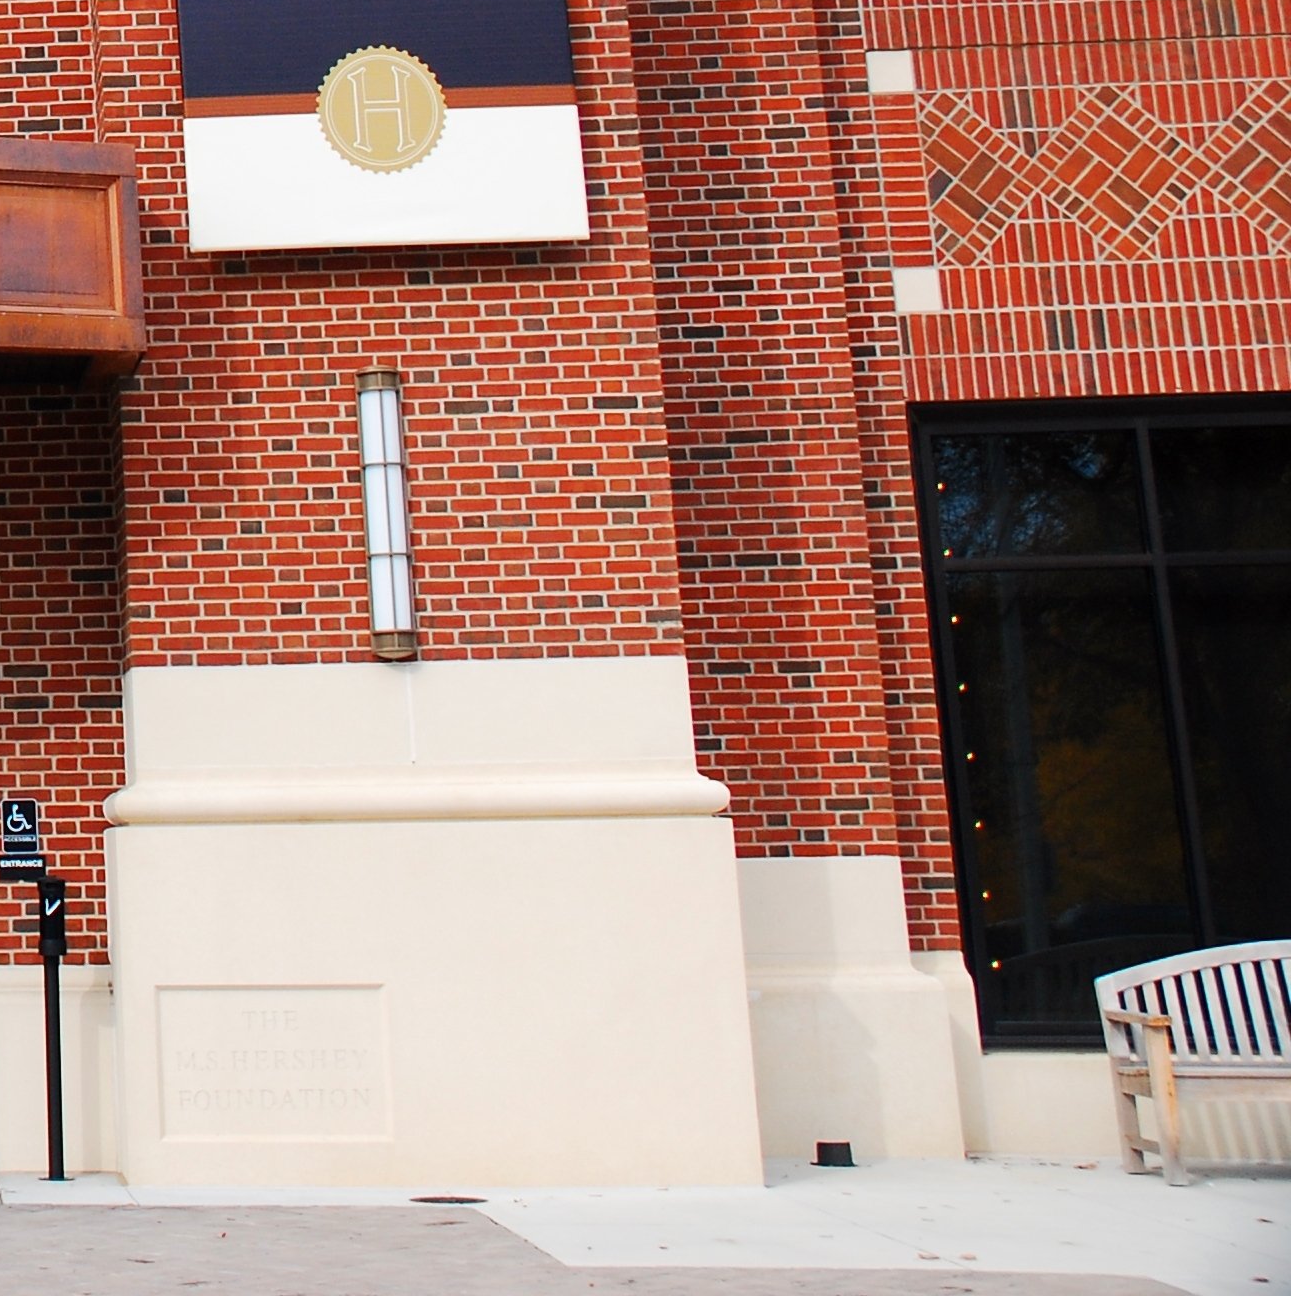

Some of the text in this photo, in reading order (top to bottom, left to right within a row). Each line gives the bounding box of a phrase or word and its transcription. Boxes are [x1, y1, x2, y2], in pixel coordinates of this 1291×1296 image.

[0, 859, 44, 868] ENTRANCE
[241, 1010, 300, 1032] THE
[231, 1048, 368, 1072] HERSHEY
[178, 1088, 372, 1112] FOUNDATION
